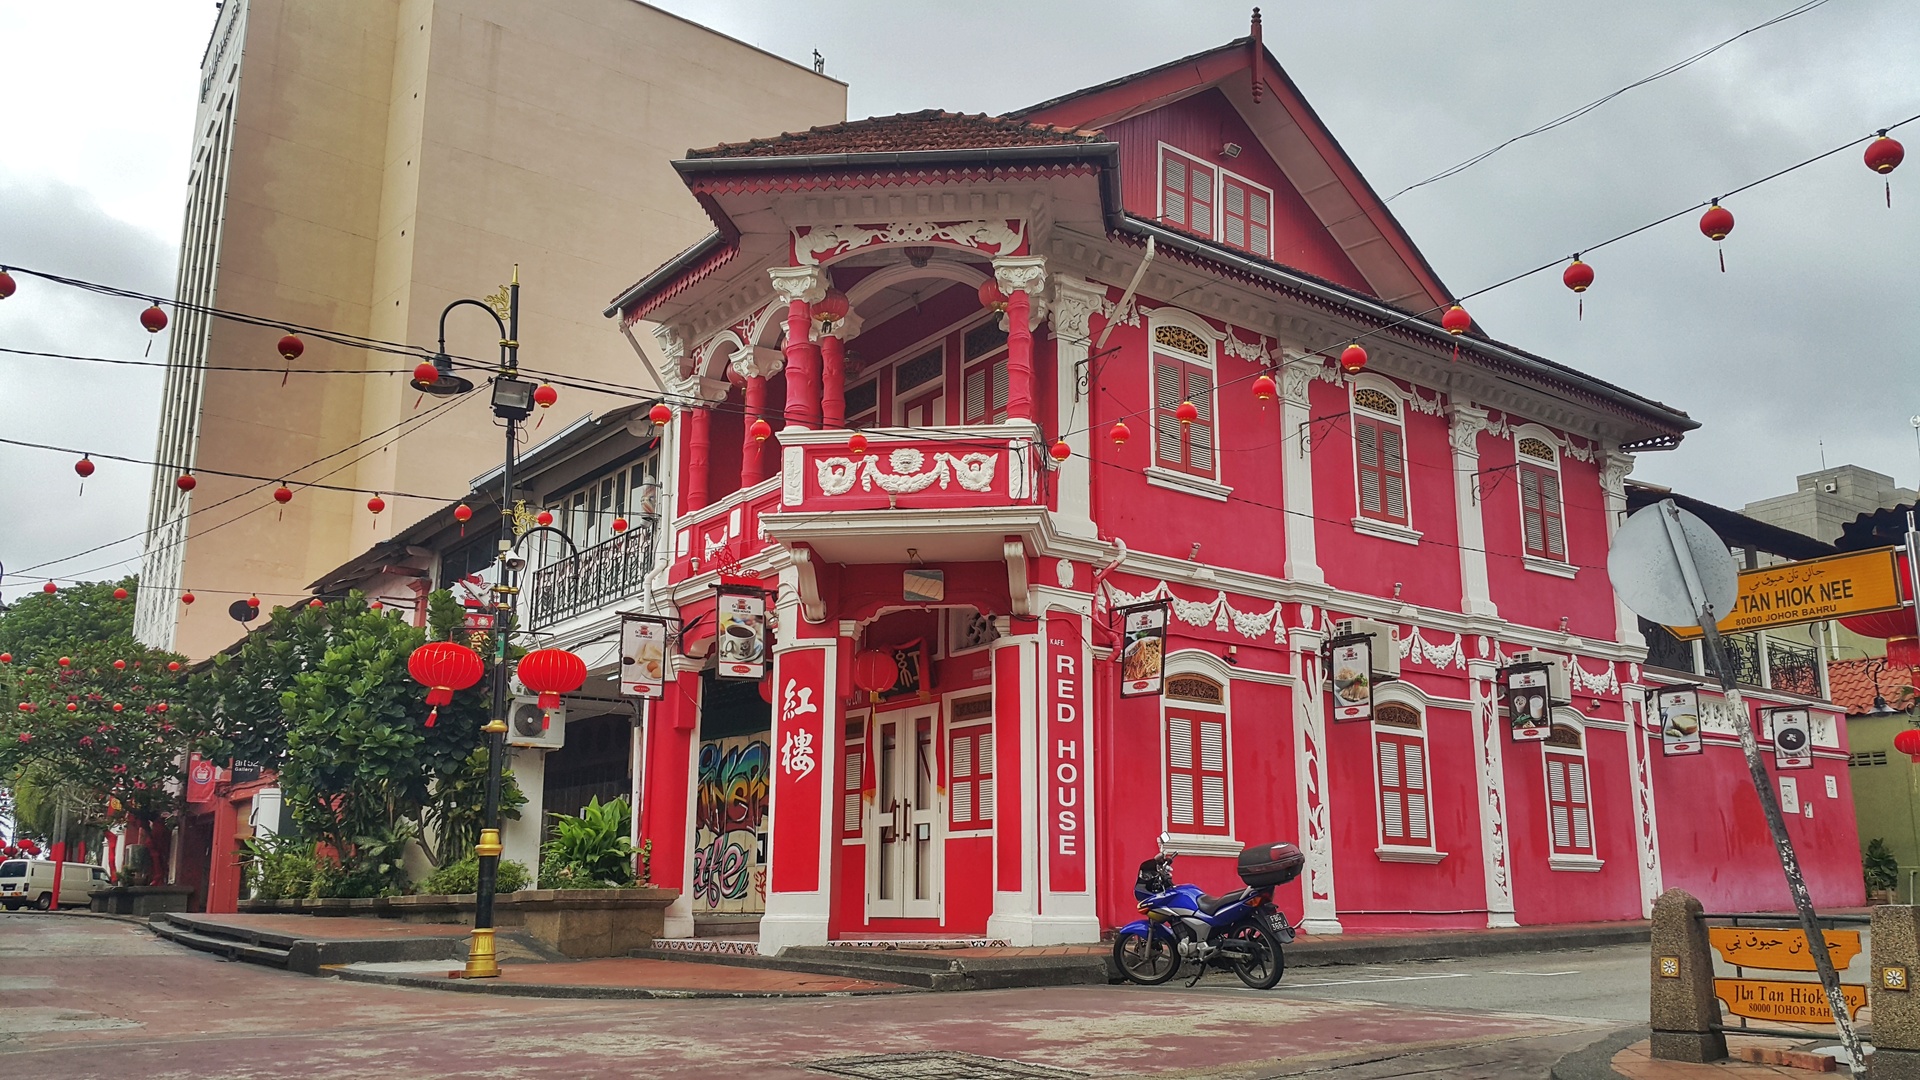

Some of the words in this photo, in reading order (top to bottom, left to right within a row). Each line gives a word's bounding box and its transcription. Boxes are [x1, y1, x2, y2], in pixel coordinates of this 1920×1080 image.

[1740, 592, 1770, 614] TAN
[1775, 585, 1815, 609] HIOK
[1820, 579, 1854, 602] NEE
[1735, 616, 1762, 626] 80000
[1765, 611, 1799, 622] JOHOR
[1801, 604, 1837, 616] BAHRU
[1050, 638, 1065, 647] KAFE
[1056, 654, 1076, 723] RED
[1056, 739, 1078, 855] HOUSE
[1270, 914, 1281, 922] FBG
[1734, 985, 1754, 1003] Jln
[1758, 986, 1784, 1002] Tan
[1791, 987, 1824, 1004] Hiok
[1748, 1003, 1770, 1013] 80000
[1774, 1004, 1806, 1016] JOHOR
[1810, 1006, 1833, 1017] BAH
